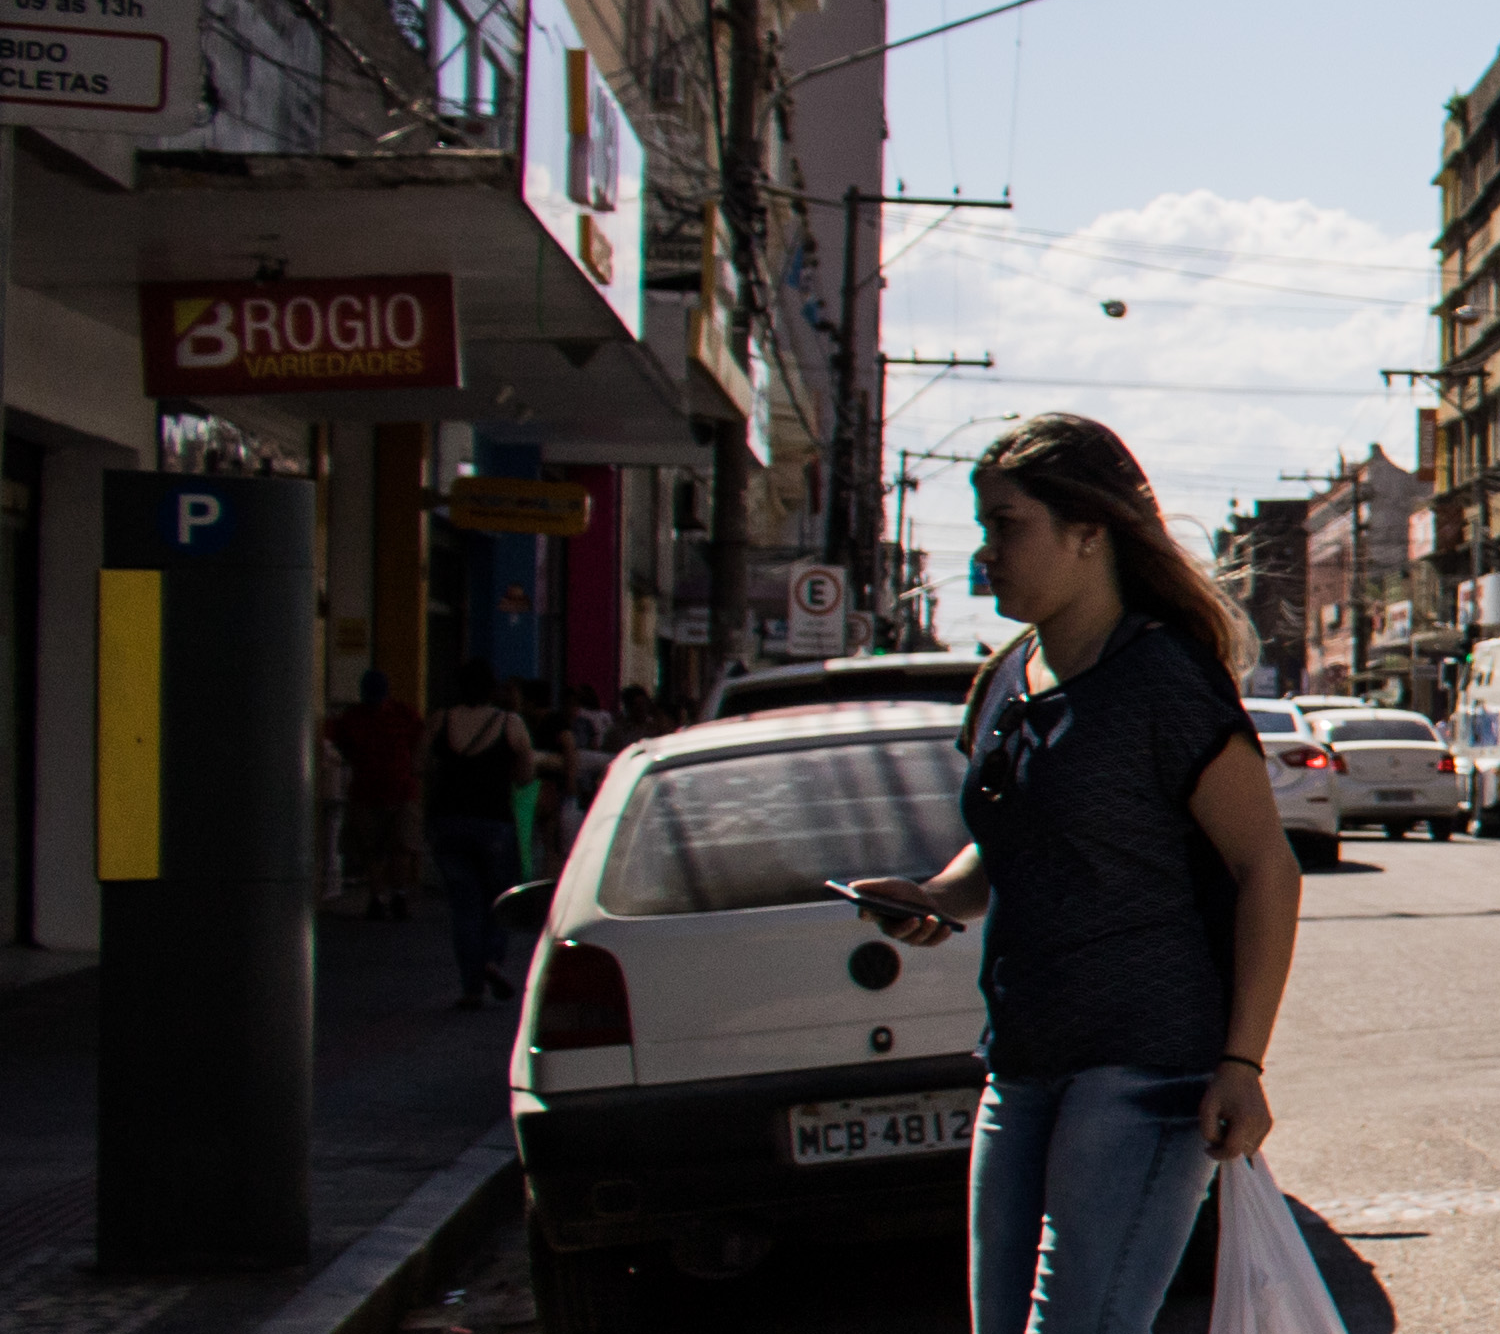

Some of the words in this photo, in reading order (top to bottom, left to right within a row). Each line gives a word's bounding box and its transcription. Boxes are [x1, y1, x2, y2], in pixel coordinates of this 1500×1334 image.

[174, 292, 425, 368] BROGIO
[245, 350, 425, 379] VARIEDADES
[180, 494, 223, 545] P
[809, 581, 825, 605] E
[798, 1109, 970, 1155] MCB-4812
